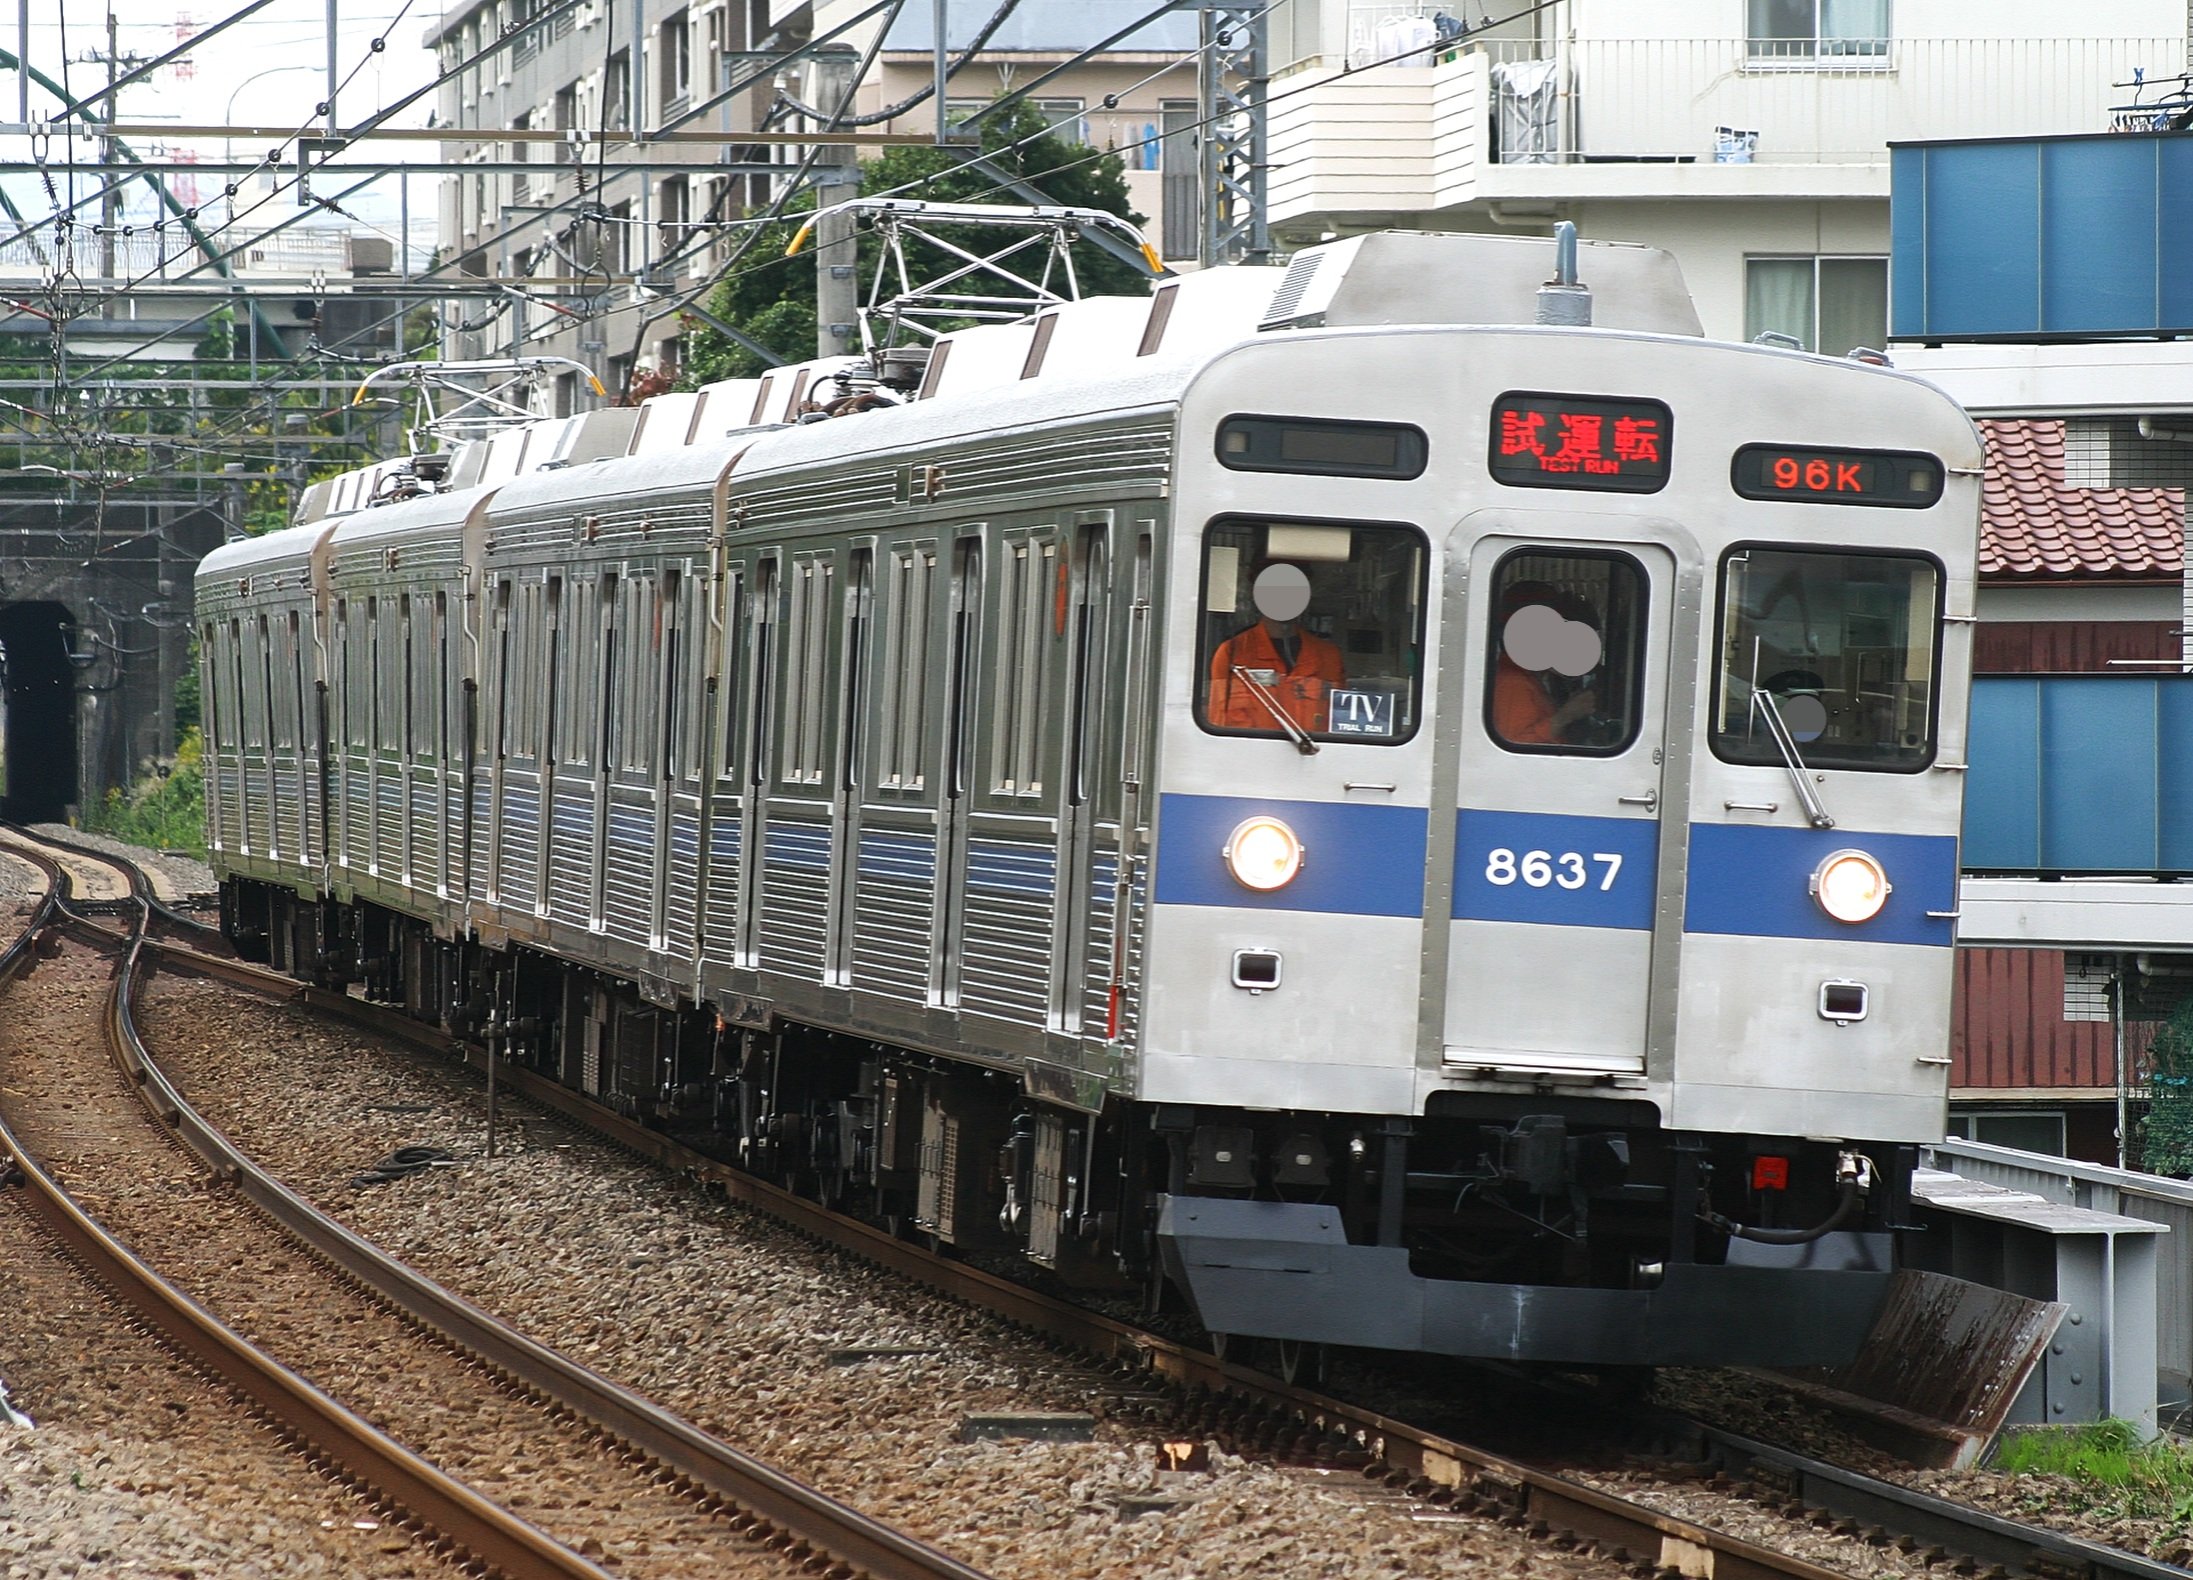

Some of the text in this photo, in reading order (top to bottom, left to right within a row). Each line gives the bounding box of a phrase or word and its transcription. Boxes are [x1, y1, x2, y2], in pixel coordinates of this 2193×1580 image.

[1501, 410, 1659, 462] 試運転
[1539, 455, 1620, 475] TEST RUN
[1773, 456, 1863, 492] 96K
[1337, 723, 1384, 733] TRIAL RUN
[1485, 848, 1623, 891] 8637
